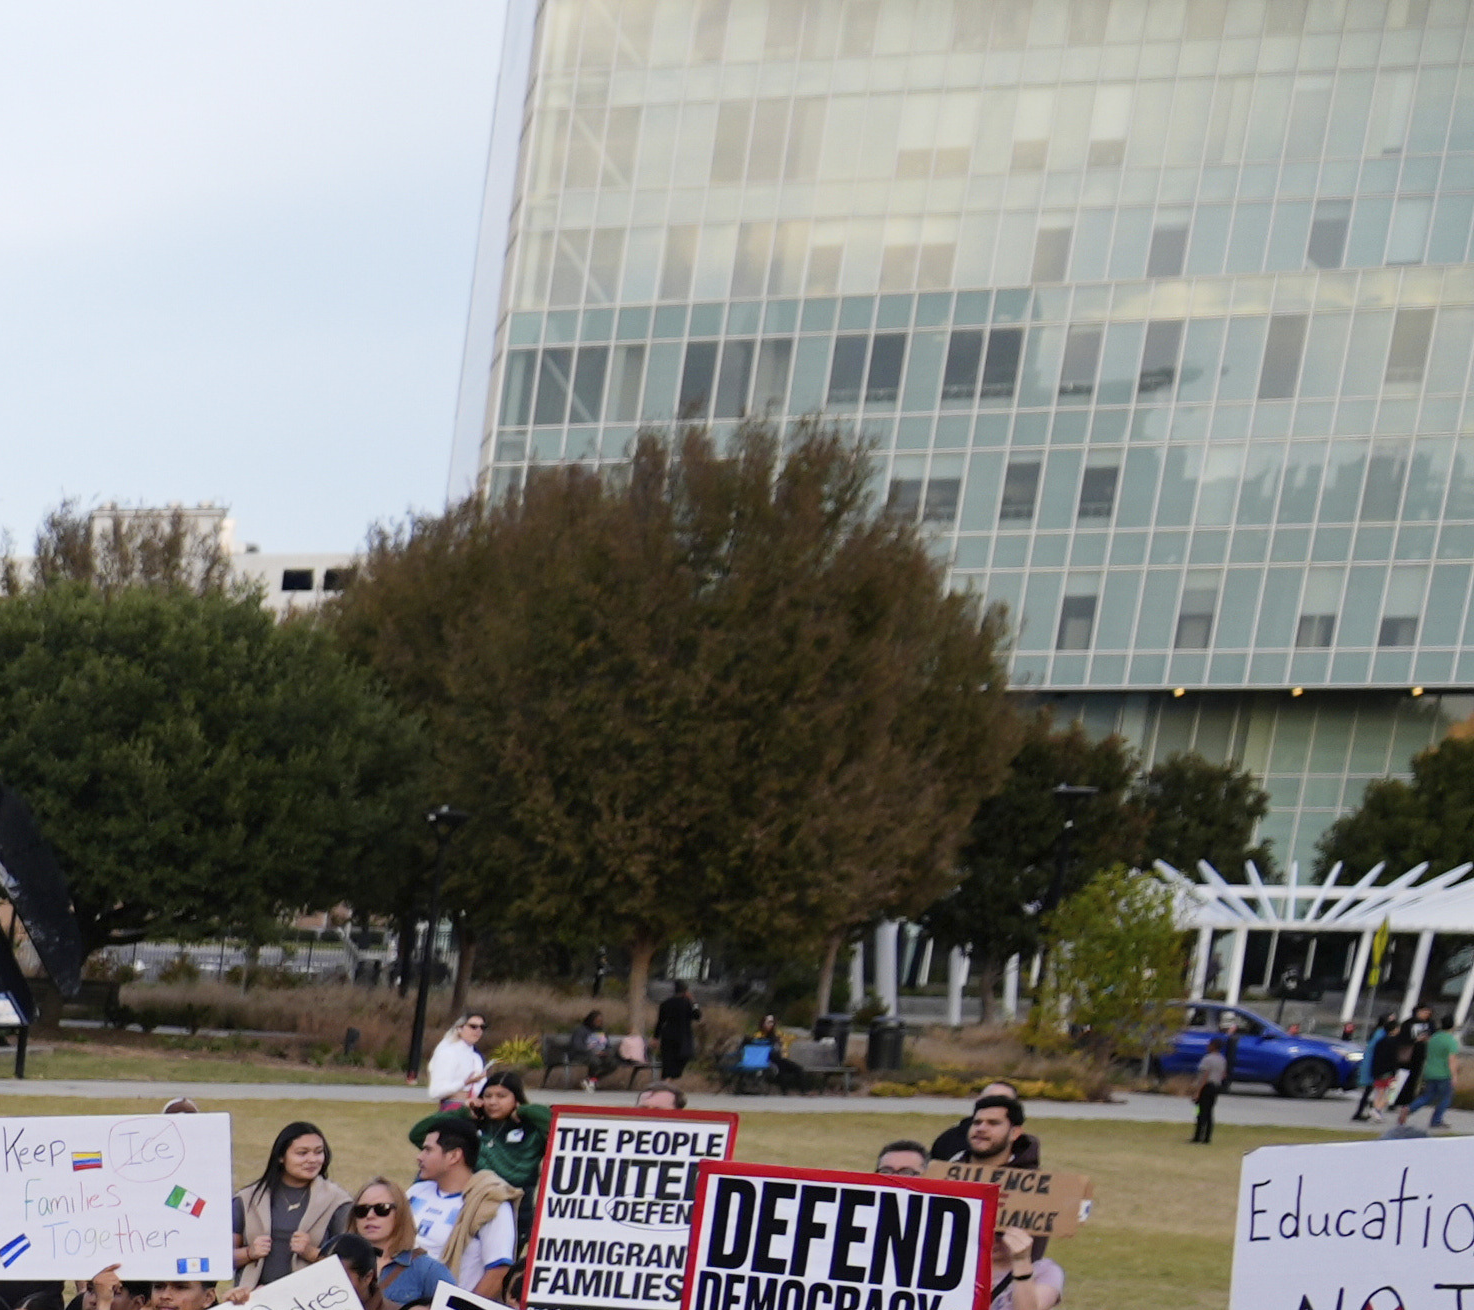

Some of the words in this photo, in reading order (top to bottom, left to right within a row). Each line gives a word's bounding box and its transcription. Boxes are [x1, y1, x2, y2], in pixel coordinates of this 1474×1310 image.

[2, 1125, 66, 1173] Keep
[557, 1127, 609, 1153] THE
[615, 1129, 725, 1158] PEOPLE
[24, 1178, 122, 1222] Families
[547, 1197, 604, 1220] WILL
[42, 1214, 180, 1260] Together
[707, 1177, 970, 1291] DEFEND
